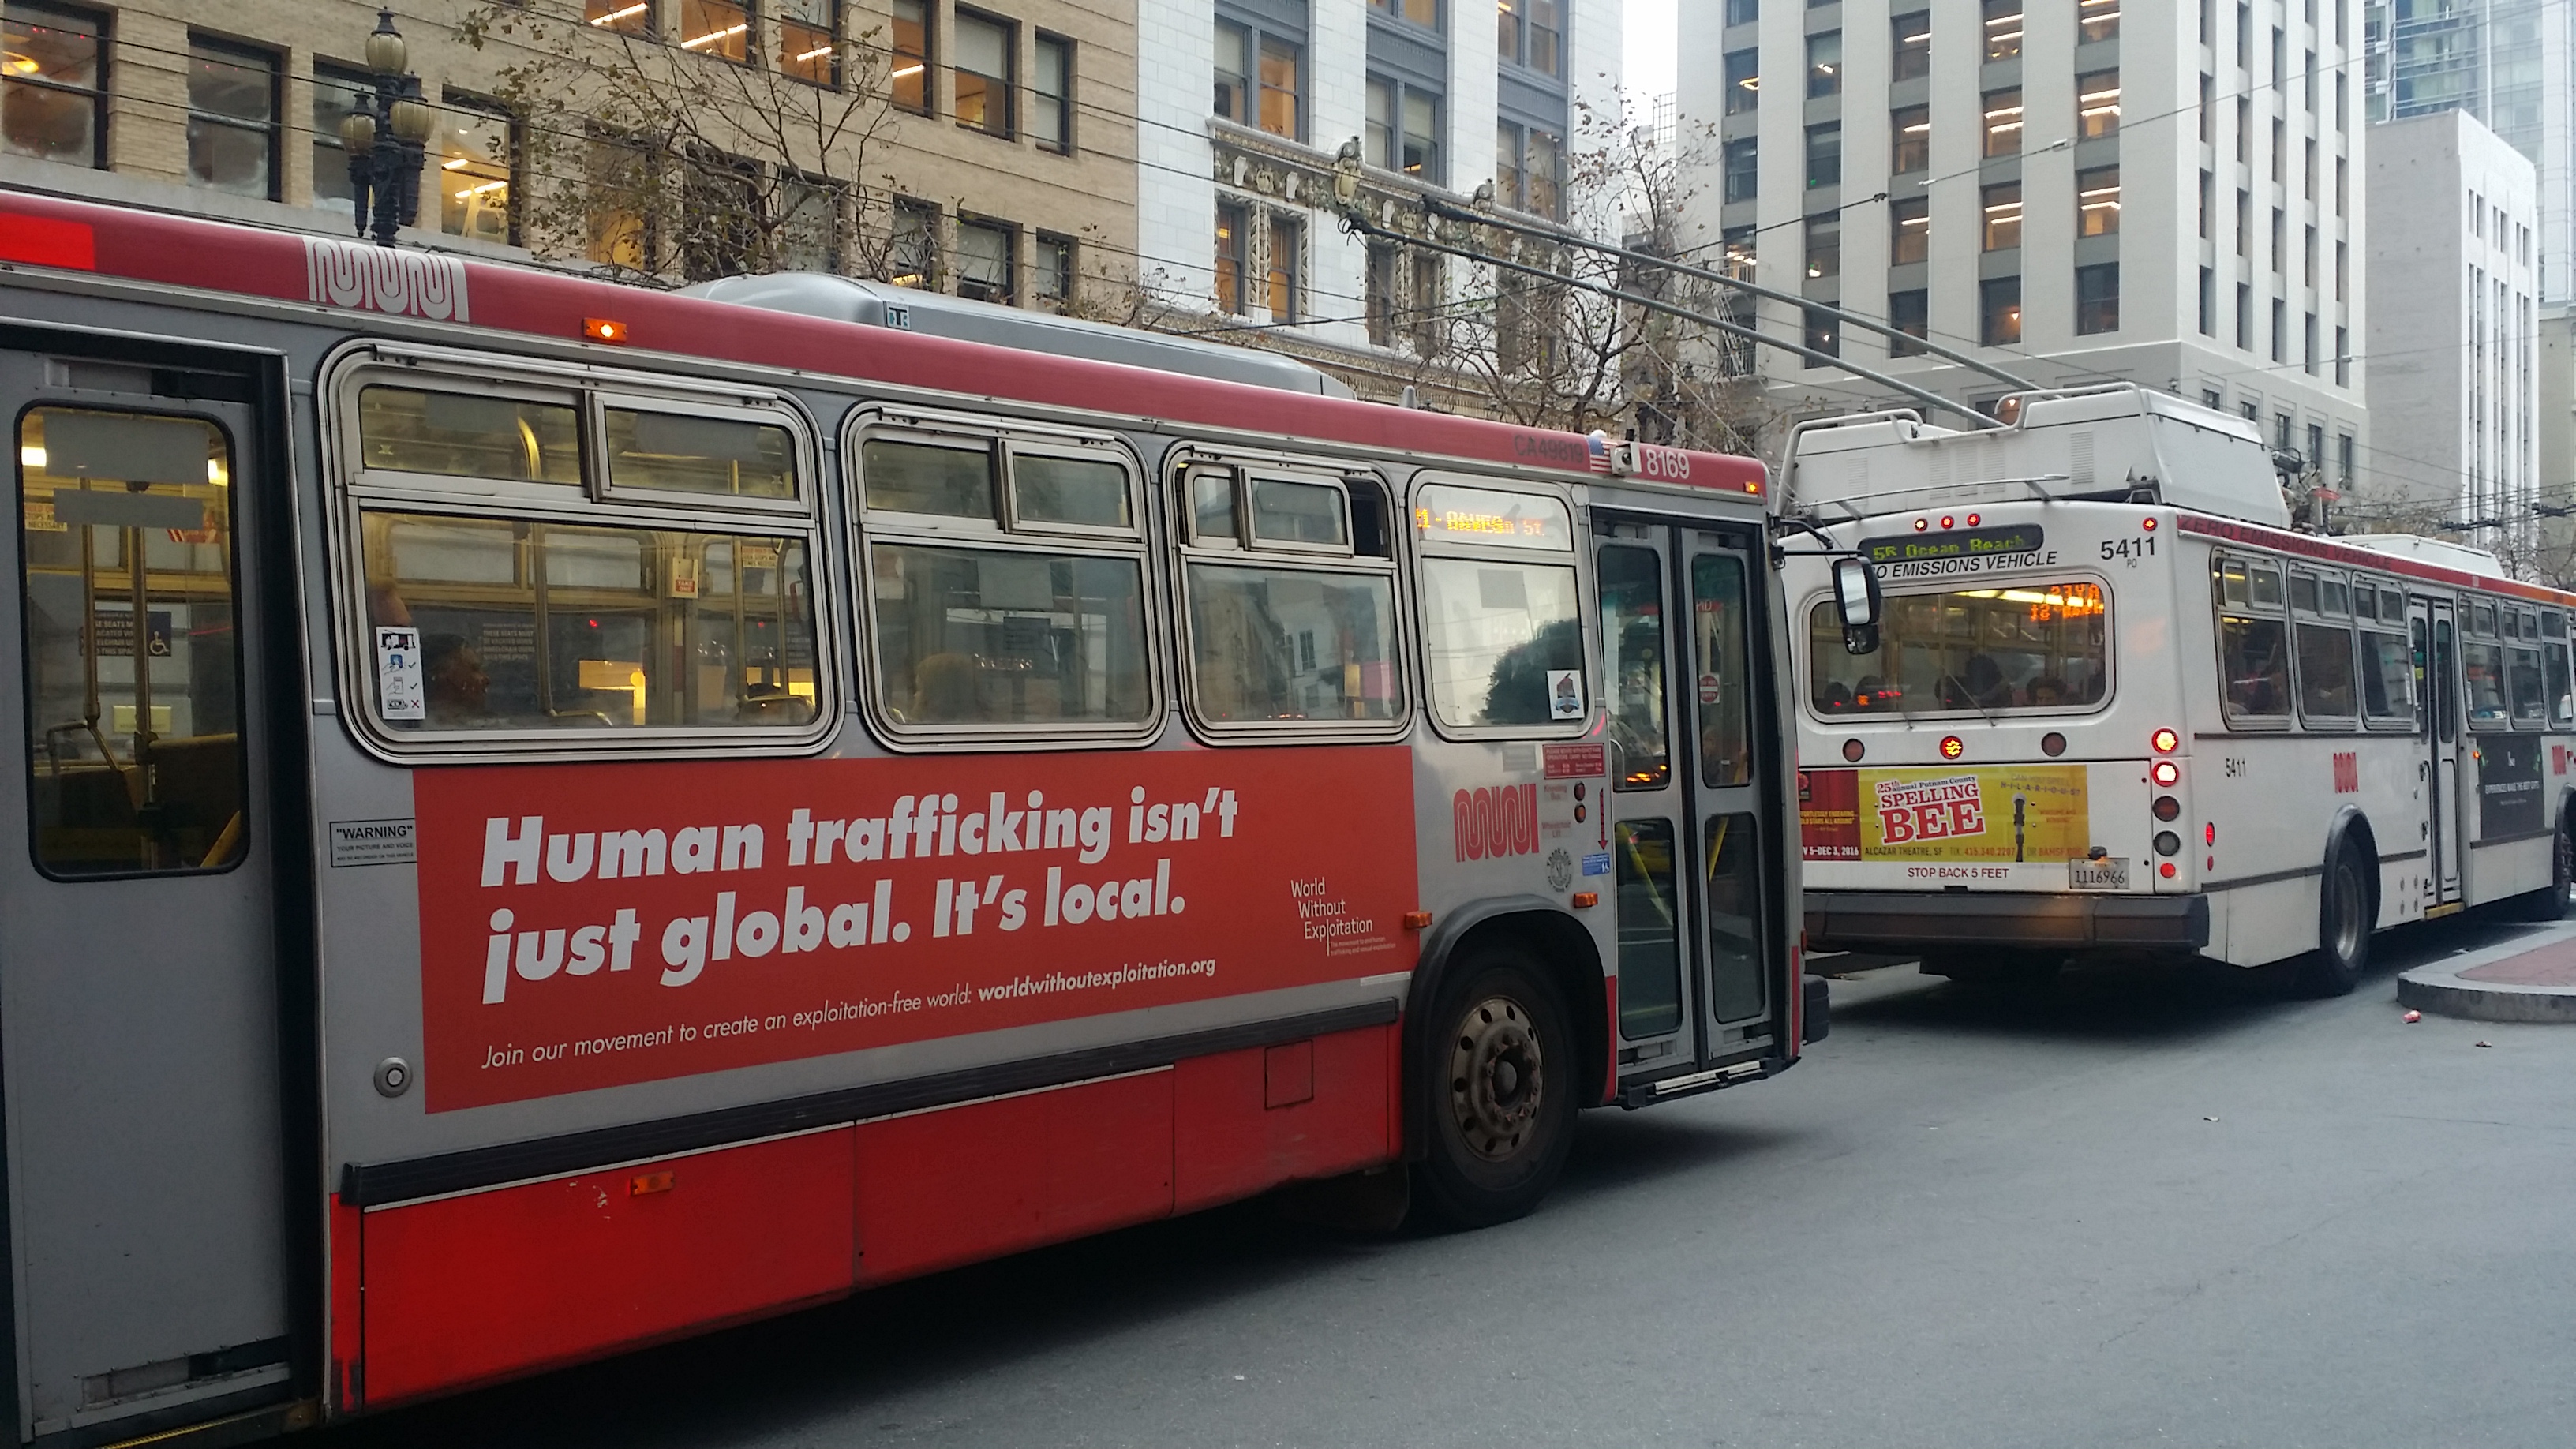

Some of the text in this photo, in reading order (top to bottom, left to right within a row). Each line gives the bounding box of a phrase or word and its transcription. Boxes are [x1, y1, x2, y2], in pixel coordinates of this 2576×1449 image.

[1646, 449, 1689, 479] 8169
[1906, 543, 1959, 557] Ocean
[2100, 537, 2156, 560] 5411
[2181, 515, 2391, 571] ZERO EMISSIONS VEHICLE
[1893, 557, 1980, 578] EMISSIONS
[1986, 552, 2057, 571] VEHICLE
[2225, 758, 2247, 777] 5411
[1877, 779, 1900, 793] 25th
[1919, 780, 1949, 788] Putnam
[1949, 776, 1977, 784] County
[1881, 784, 1979, 809] SPELLING
[336, 825, 413, 839] "WARNING"
[1880, 799, 1984, 844] BEE
[481, 816, 764, 887] Human
[787, 789, 1112, 866] trafficking
[1841, 846, 1859, 856] 2016
[1865, 847, 1896, 856] ALCAZAR
[1934, 847, 1943, 856] SF
[1908, 867, 2009, 878] STOP BACK 5 FEET
[2075, 870, 2125, 884] 1116966
[1290, 877, 1326, 898] World
[1297, 898, 1346, 919] Without
[482, 908, 642, 1005] just
[659, 879, 911, 987] global.
[1043, 858, 1185, 927] local.
[1304, 916, 1373, 952] Exploitation
[481, 957, 1216, 1069] Join our movement to create an exploitation-free world: worldwithoutexploitation.org
